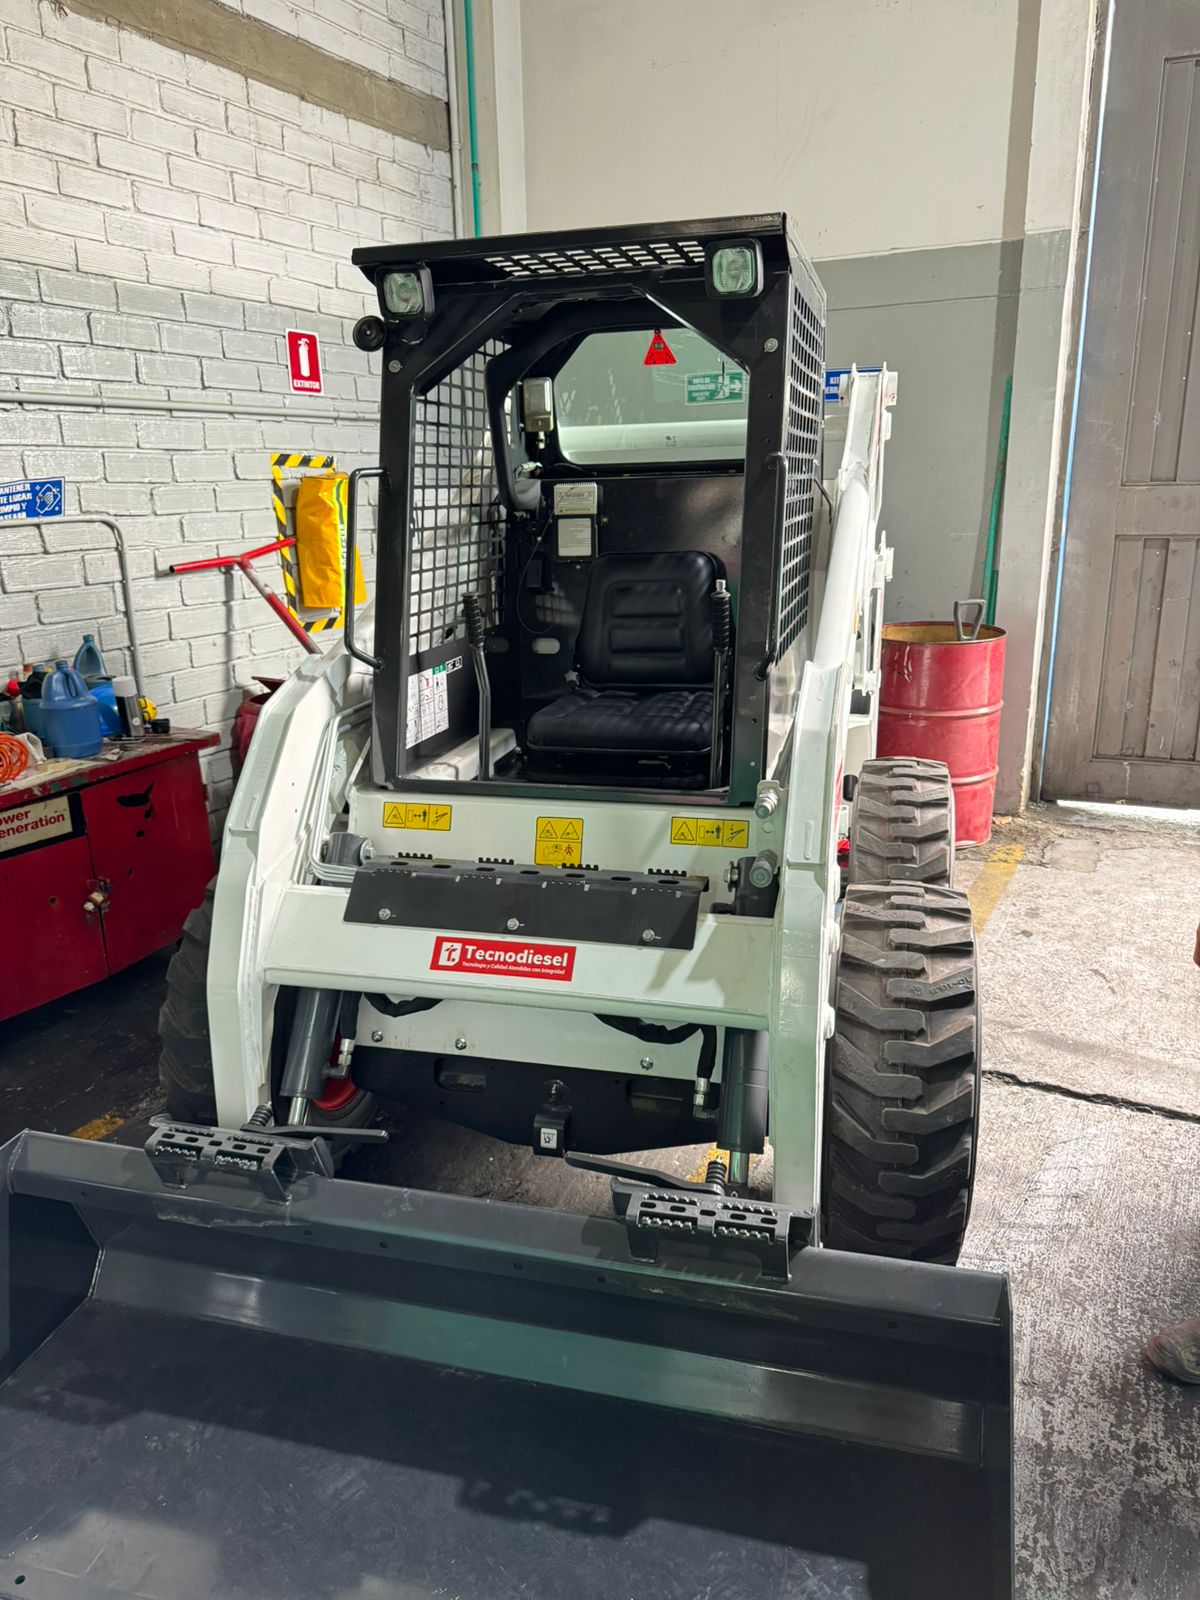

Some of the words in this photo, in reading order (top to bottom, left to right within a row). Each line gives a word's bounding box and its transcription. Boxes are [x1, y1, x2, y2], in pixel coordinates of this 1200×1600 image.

[293, 379, 320, 389] EXTINTOR
[9, 492, 32, 503] LUGAR
[21, 502, 27, 510] Y
[465, 945, 568, 967] Tecnodiesel
